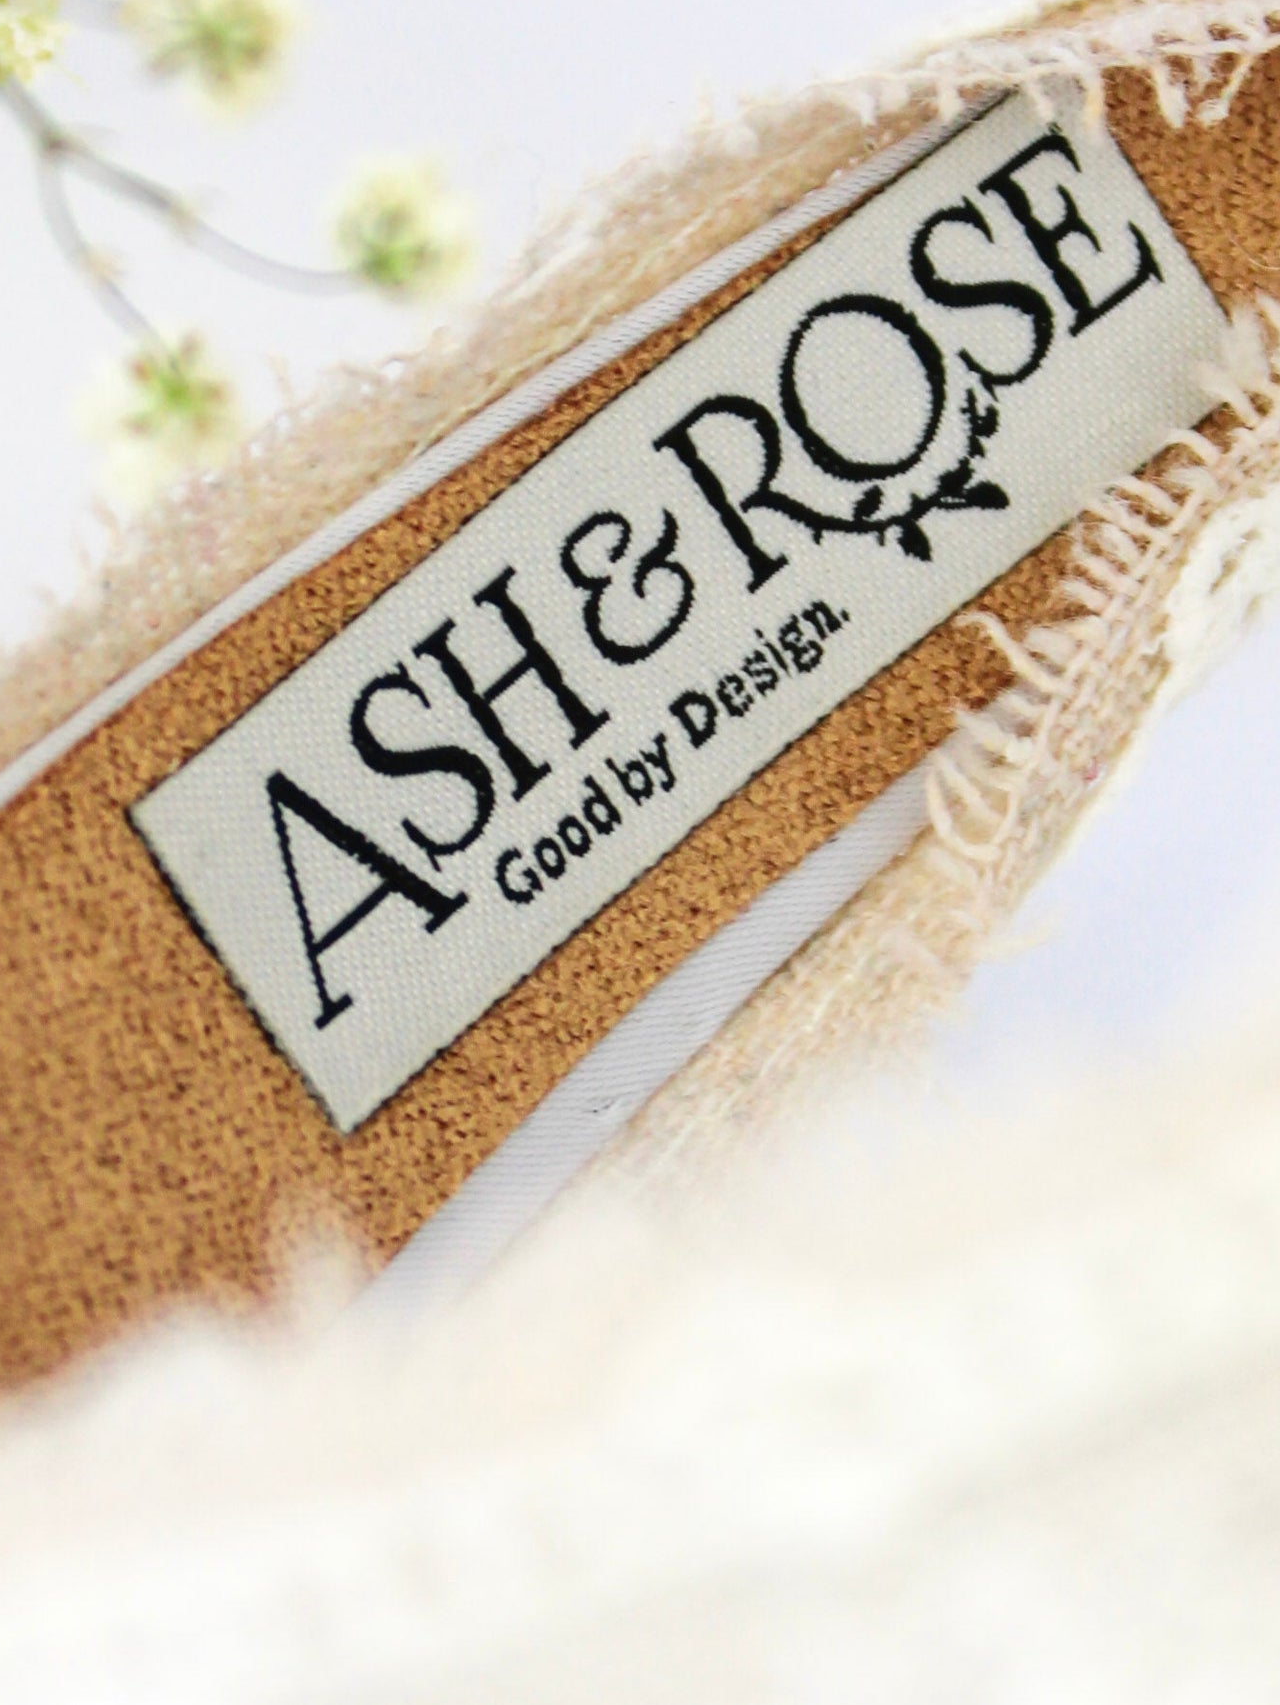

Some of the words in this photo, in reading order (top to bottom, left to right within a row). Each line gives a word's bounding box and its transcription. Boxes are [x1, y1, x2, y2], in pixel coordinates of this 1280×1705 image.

[264, 565, 612, 1031] ASH
[558, 507, 696, 667] &
[652, 122, 1165, 595] ROSE
[493, 773, 623, 905] Good
[604, 731, 677, 807] by
[668, 599, 851, 750] Design.
